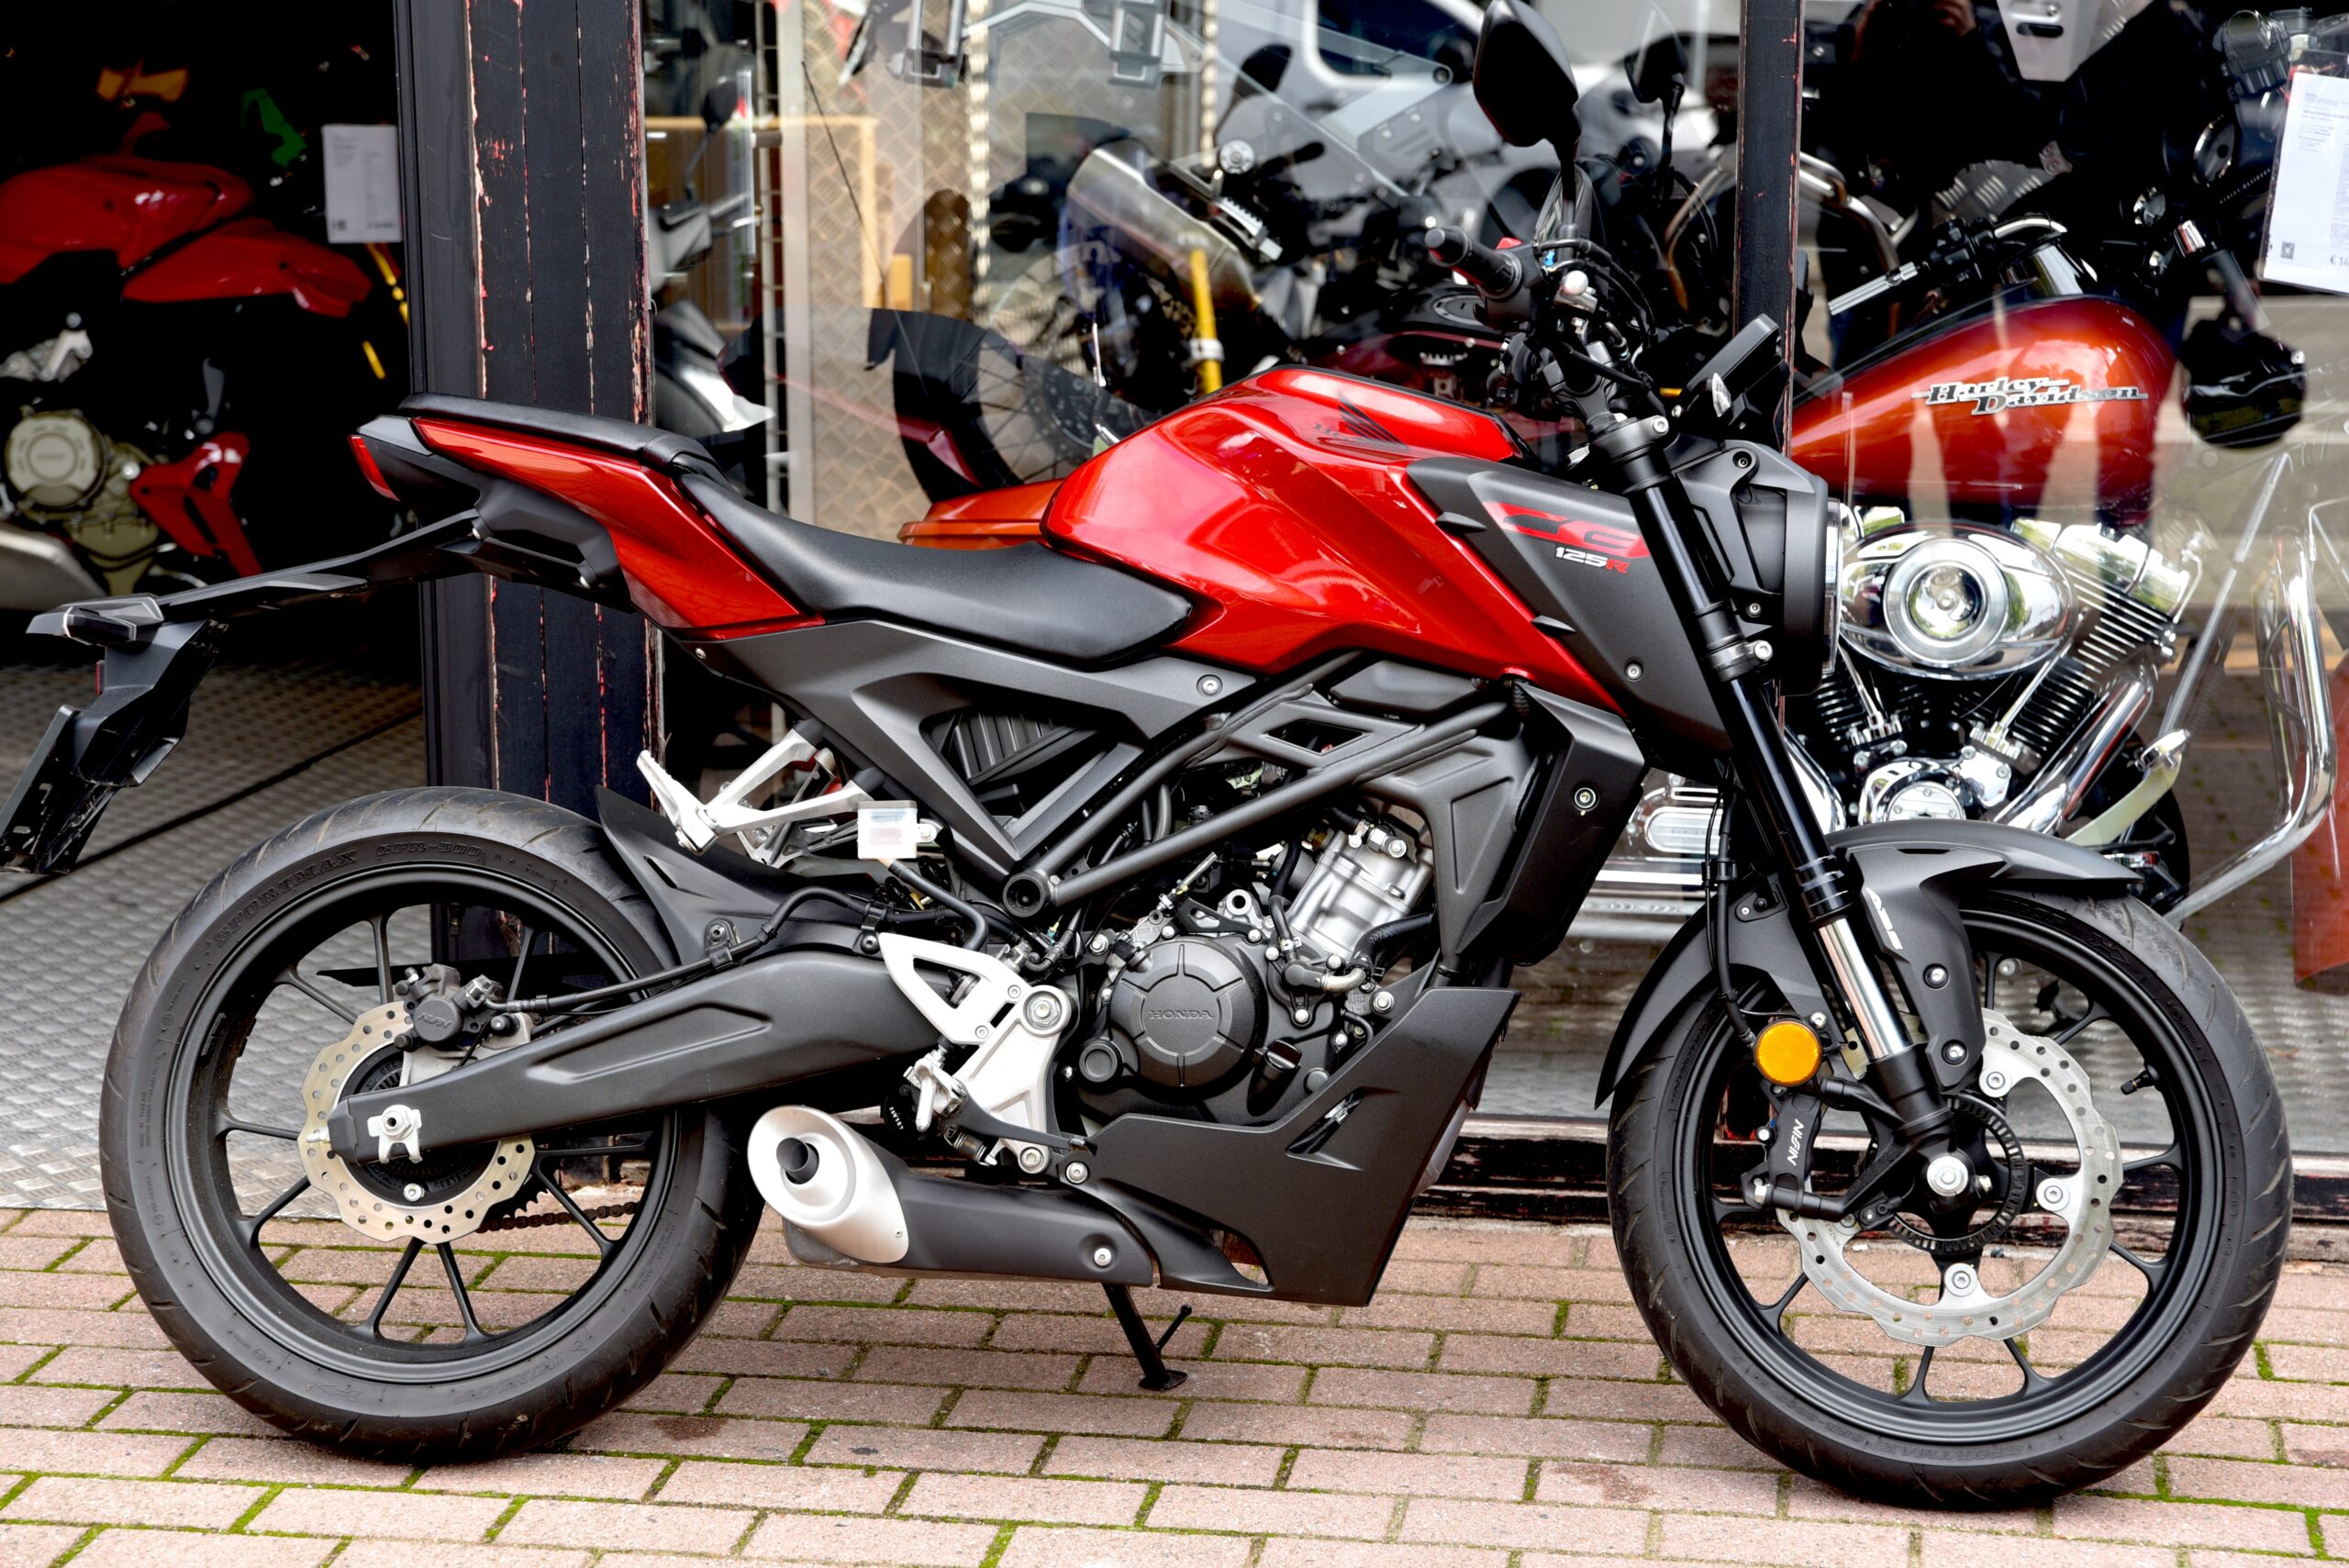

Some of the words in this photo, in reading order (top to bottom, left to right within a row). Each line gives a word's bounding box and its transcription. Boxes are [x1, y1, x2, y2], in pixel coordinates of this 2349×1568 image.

[1925, 376, 2057, 405] Harley
[1971, 385, 2148, 416] Davidson
[1555, 547, 1631, 574] 125R
[214, 850, 358, 948] SPORTMAX
[375, 840, 484, 857] GPR-300
[1148, 1010, 1213, 1019] HONDA
[1878, 1443, 2025, 1461] SPORTMAX
